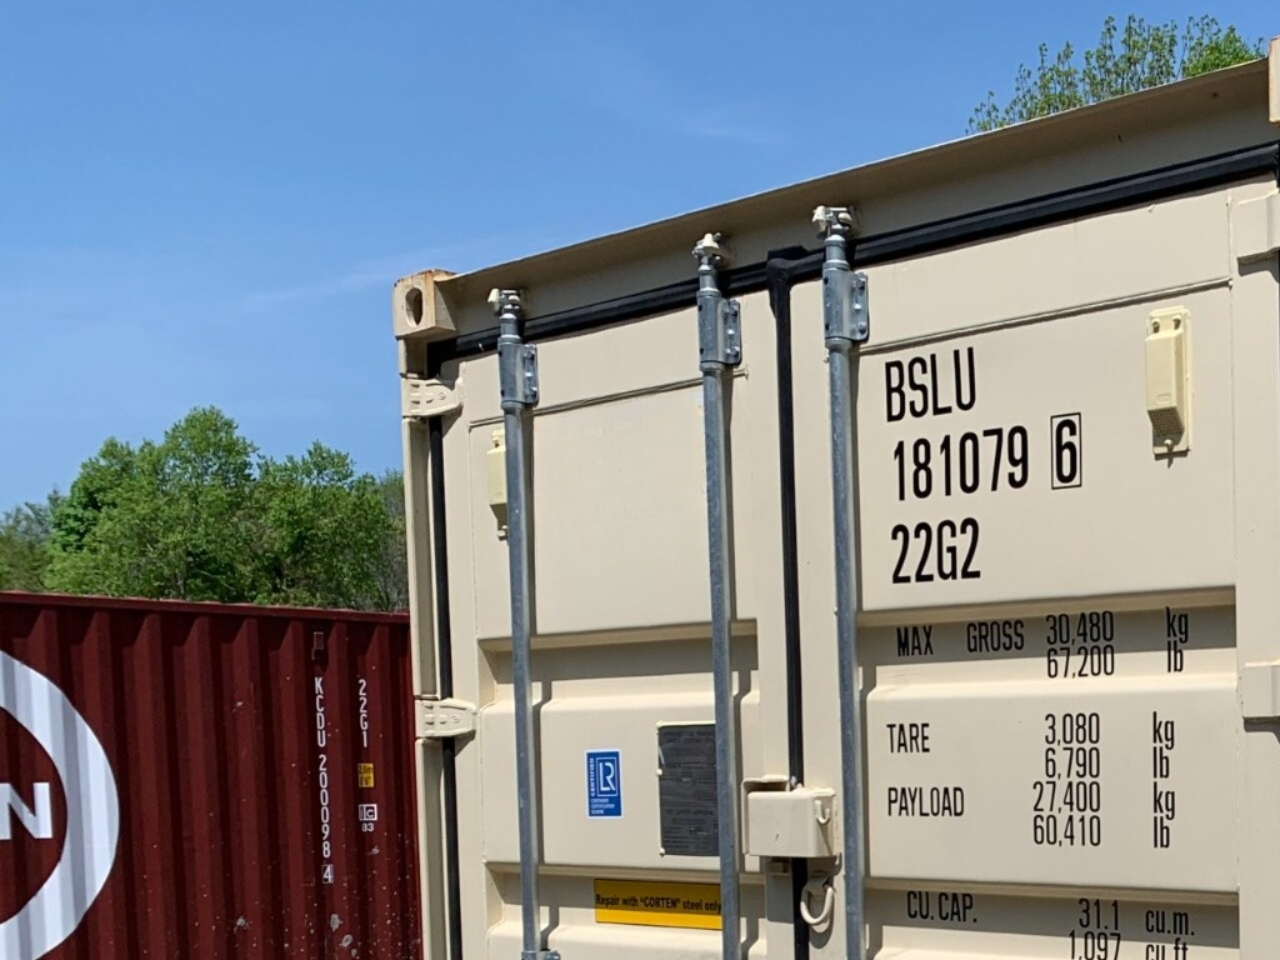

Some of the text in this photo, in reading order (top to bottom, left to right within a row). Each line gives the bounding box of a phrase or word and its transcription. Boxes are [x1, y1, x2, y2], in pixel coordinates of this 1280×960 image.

[884, 346, 976, 422] BSLU
[894, 418, 1078, 501] 181079 6
[891, 517, 981, 584] 22G2
[896, 606, 1189, 656] MAX GROSS 30,480 kg
[1047, 640, 1184, 679] 67,200 lb
[314, 677, 326, 747] KCDU
[358, 679, 369, 748] 22G1
[887, 711, 1175, 753] TARE 3,080 kg
[1045, 746, 1170, 780] 6,790 lb
[318, 754, 331, 858] 200098
[888, 781, 1175, 820] PAYLOAD 27,400 kg
[1033, 815, 1170, 849] 60,410 lb
[595, 893, 620, 908] Repair
[622, 895, 639, 907] with
[683, 899, 703, 911] steel
[1078, 897, 1121, 931] 31.1
